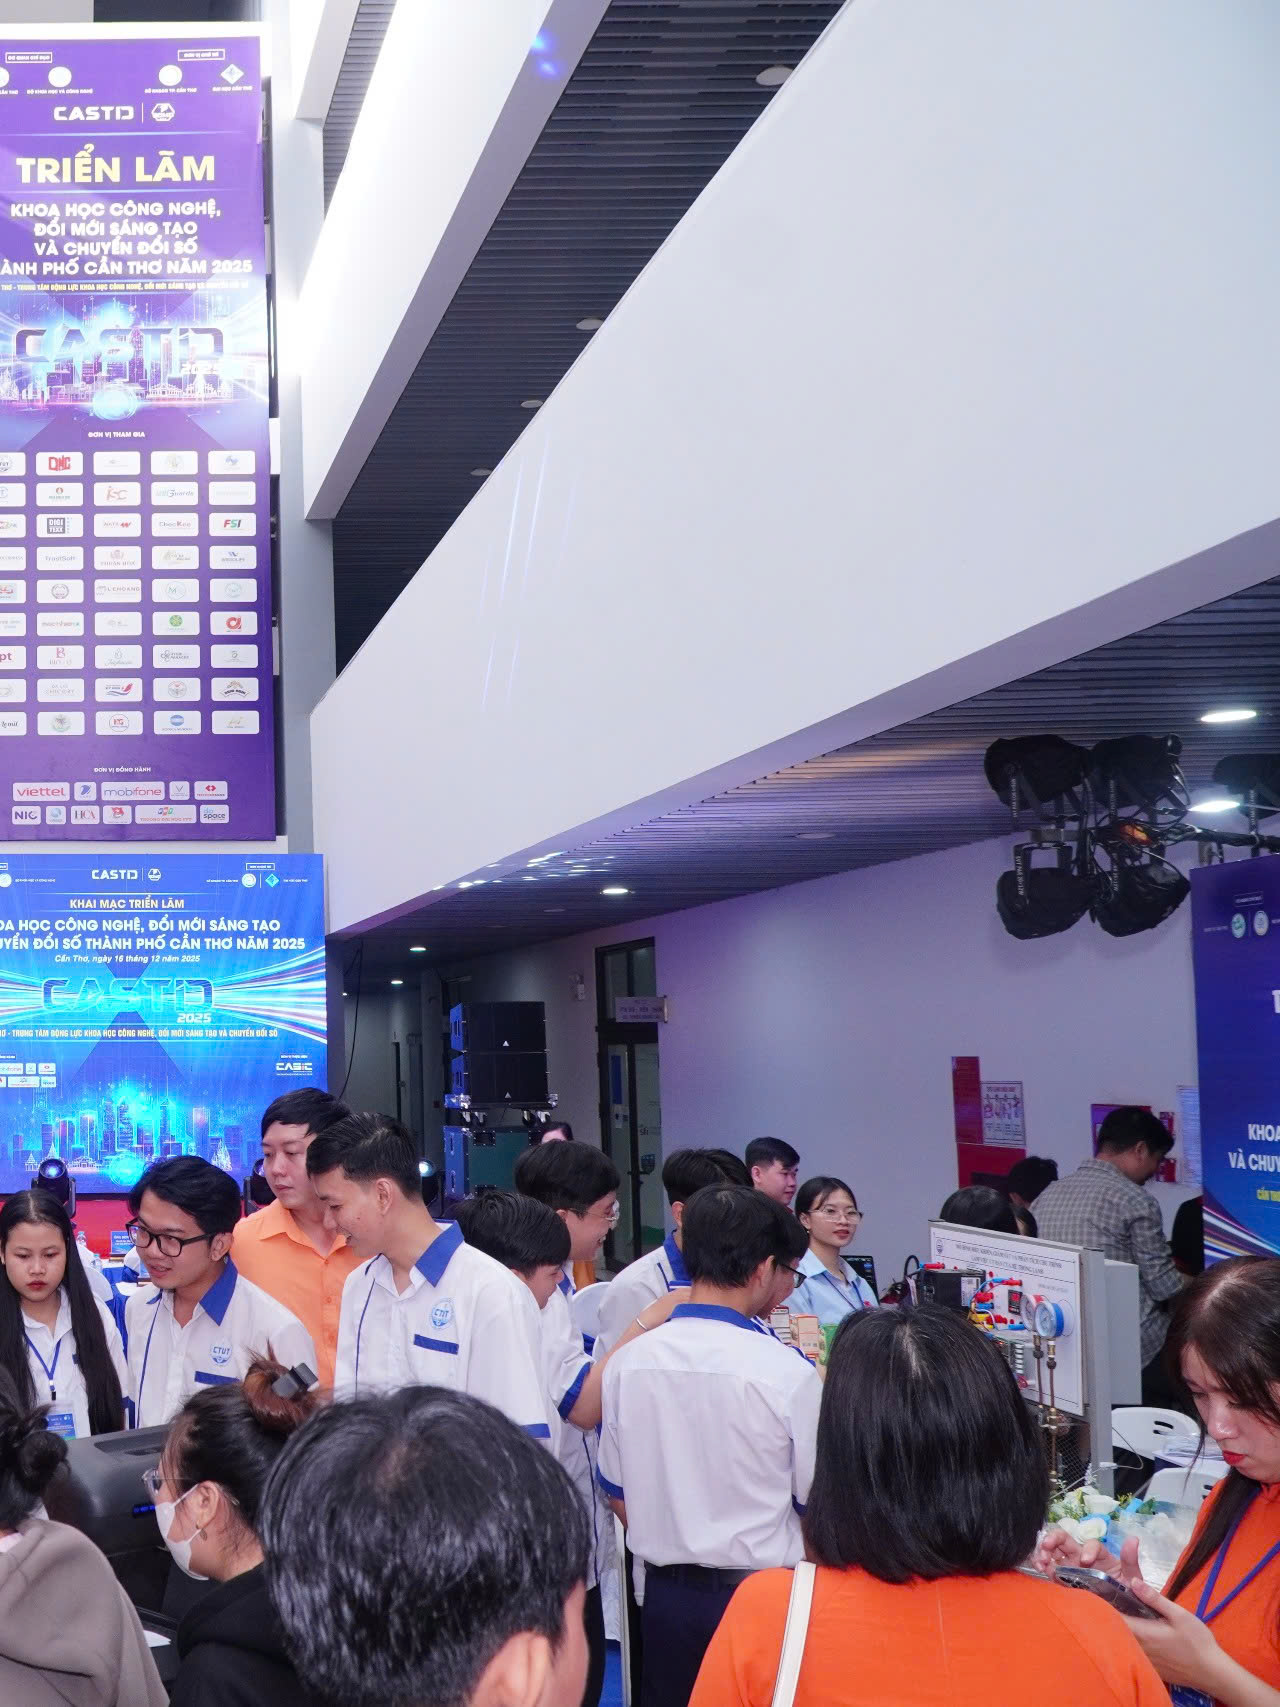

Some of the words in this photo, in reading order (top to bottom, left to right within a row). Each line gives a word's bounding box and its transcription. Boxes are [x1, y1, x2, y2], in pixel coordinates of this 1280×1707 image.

[16, 144, 120, 183] TRIỂN
[136, 150, 214, 182] LÃM
[10, 204, 60, 217] KHOA
[66, 203, 104, 220] HỌC
[110, 200, 163, 216] CÔNG
[169, 198, 220, 218] NGHỆ,
[34, 217, 65, 236] ĐỔI
[71, 219, 104, 235] MỚI
[110, 219, 158, 235] SÁNG
[163, 222, 198, 238] TẠO
[34, 240, 58, 256] VÀ
[64, 236, 134, 255] CHUYỂN
[137, 234, 168, 254] ĐỔI
[174, 236, 198, 254] SỐ
[42, 257, 79, 275] PHỐ
[84, 256, 122, 274] CẦN
[127, 259, 162, 274] THƠ
[167, 258, 206, 274] NĂM
[212, 260, 252, 273] 2025
[224, 520, 242, 528] FSI
[17, 788, 65, 796] viettel
[104, 787, 162, 796] mobifone
[70, 900, 96, 908] KHAI
[100, 900, 126, 911] MẠC
[129, 894, 158, 908] TRIỂN
[162, 898, 184, 908] LÃM
[18, 920, 50, 934] HỌC
[55, 917, 98, 931] CÔNG
[102, 917, 144, 934] NGHỆ,
[149, 914, 174, 931] ĐỔI
[178, 917, 205, 931] MỚI
[210, 917, 248, 931] SÁNG
[252, 920, 280, 934] TẠO
[33, 932, 58, 949] ĐỔI
[63, 934, 82, 949] SỐ
[85, 935, 132, 949] THÀNH
[136, 934, 166, 949] PHỐ
[170, 933, 200, 949] CẦN
[204, 937, 232, 949] THƠ
[237, 936, 268, 949] NĂM
[272, 938, 305, 949] 2025
[55, 954, 70, 962] Cần
[73, 955, 90, 963] Thơ,
[92, 956, 112, 964] ngày
[126, 955, 148, 964] tháng
[177, 1012, 212, 1023] 2025
[1228, 1148, 1246, 1170] VÀ
